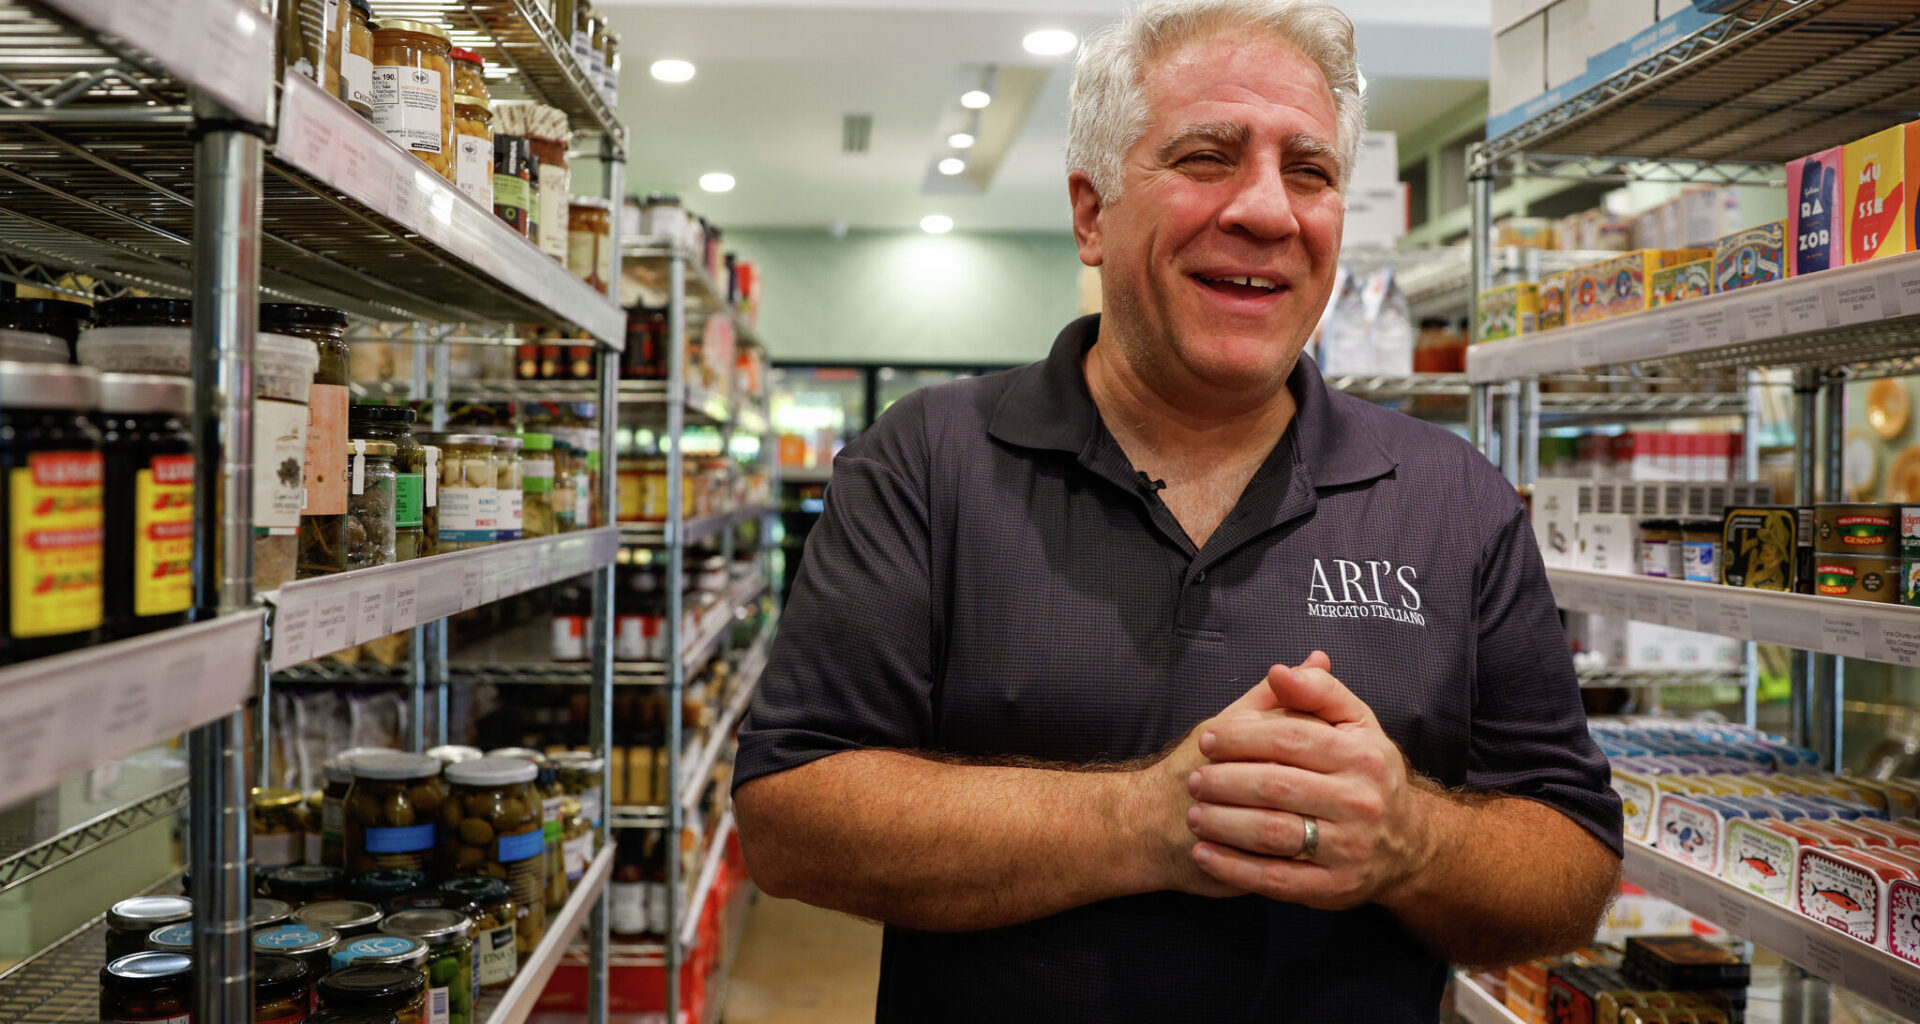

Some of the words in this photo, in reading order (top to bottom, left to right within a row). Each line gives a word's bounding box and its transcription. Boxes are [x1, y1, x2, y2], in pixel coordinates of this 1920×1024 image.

[1859, 164, 1881, 185] MU
[1801, 198, 1824, 218] RA
[1858, 197, 1883, 219] SSE
[1798, 229, 1829, 251] ZOR
[1863, 232, 1878, 251] LS
[1843, 536, 1884, 545] GENOVA
[1307, 558, 1421, 611] ARI'S
[1308, 603, 1369, 618] MERCATO
[1370, 604, 1426, 626] ITALIANO
